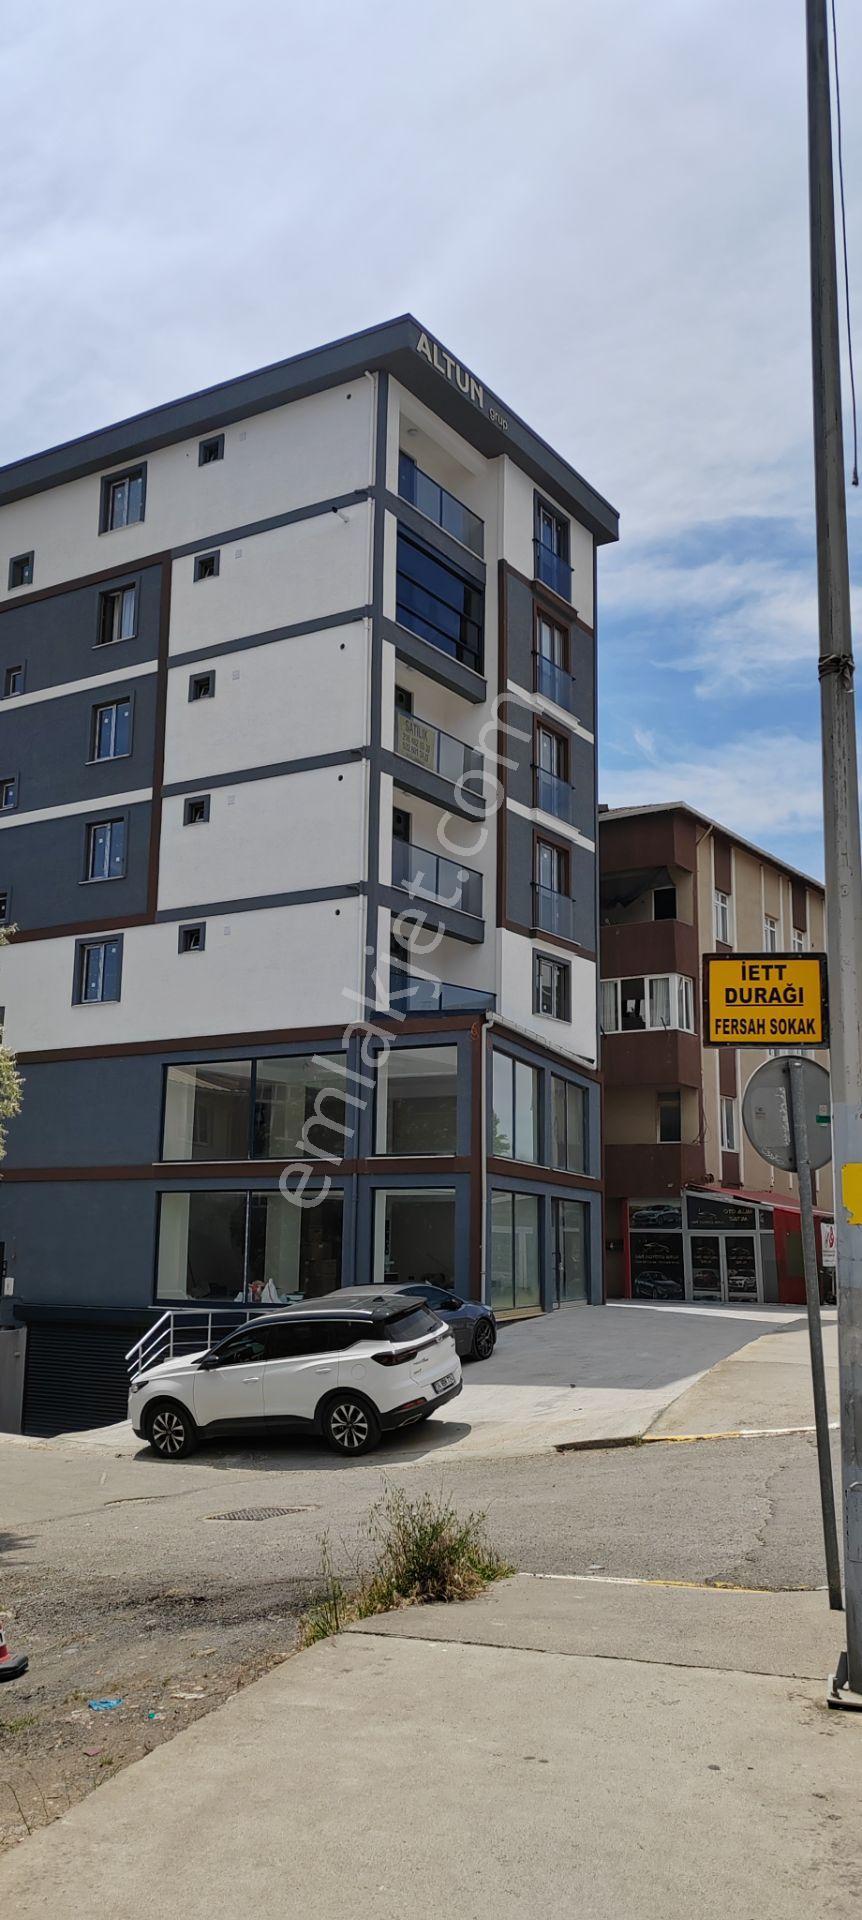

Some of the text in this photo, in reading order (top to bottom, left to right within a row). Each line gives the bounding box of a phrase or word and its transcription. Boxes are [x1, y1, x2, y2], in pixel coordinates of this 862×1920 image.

[416, 332, 508, 430] ALTUN grup
[741, 961, 787, 981] İETT
[725, 983, 804, 1004] DURAĞI
[715, 1018, 816, 1035] FERSAH SOKAK
